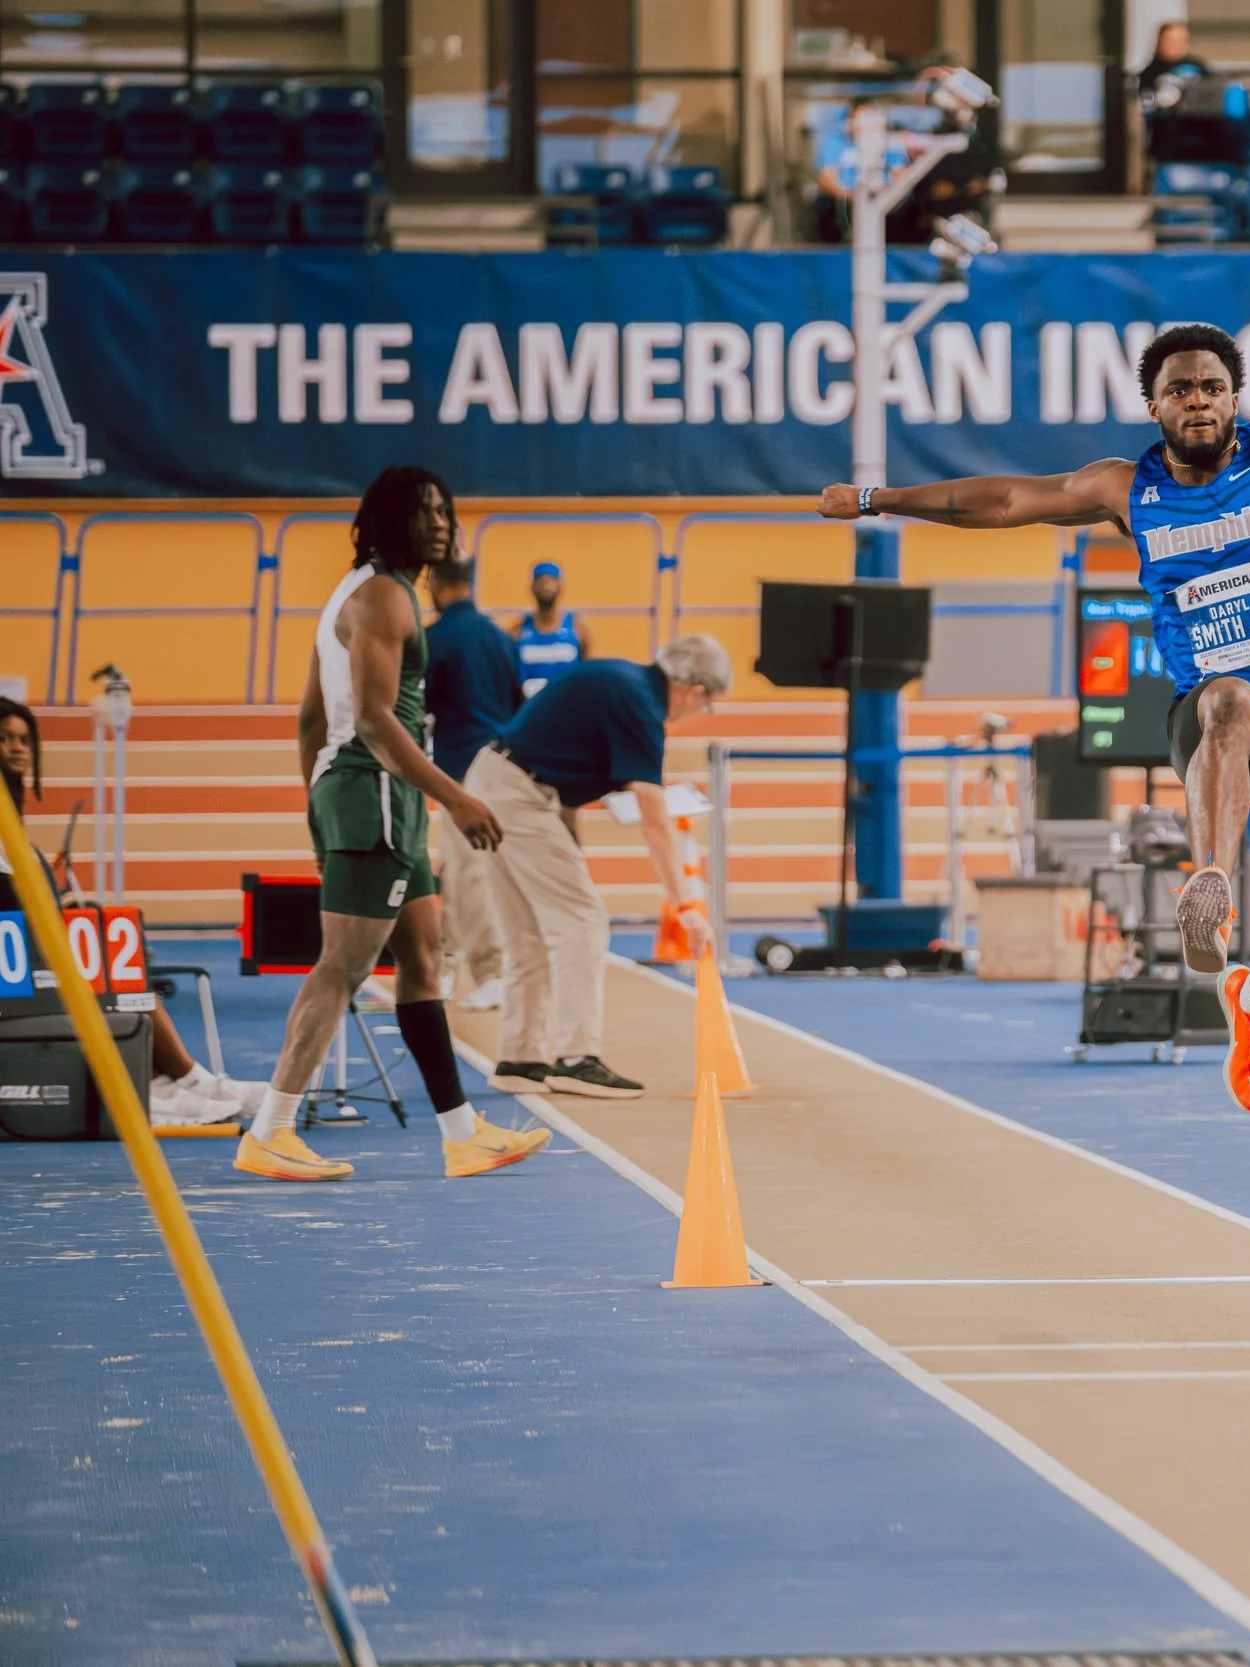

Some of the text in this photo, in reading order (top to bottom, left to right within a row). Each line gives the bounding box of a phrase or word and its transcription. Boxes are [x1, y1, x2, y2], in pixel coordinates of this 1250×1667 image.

[208, 323, 414, 424] THE
[439, 320, 1012, 425] AMERICAN
[1209, 598, 1250, 620] DARYL
[1190, 614, 1247, 651] SMITH
